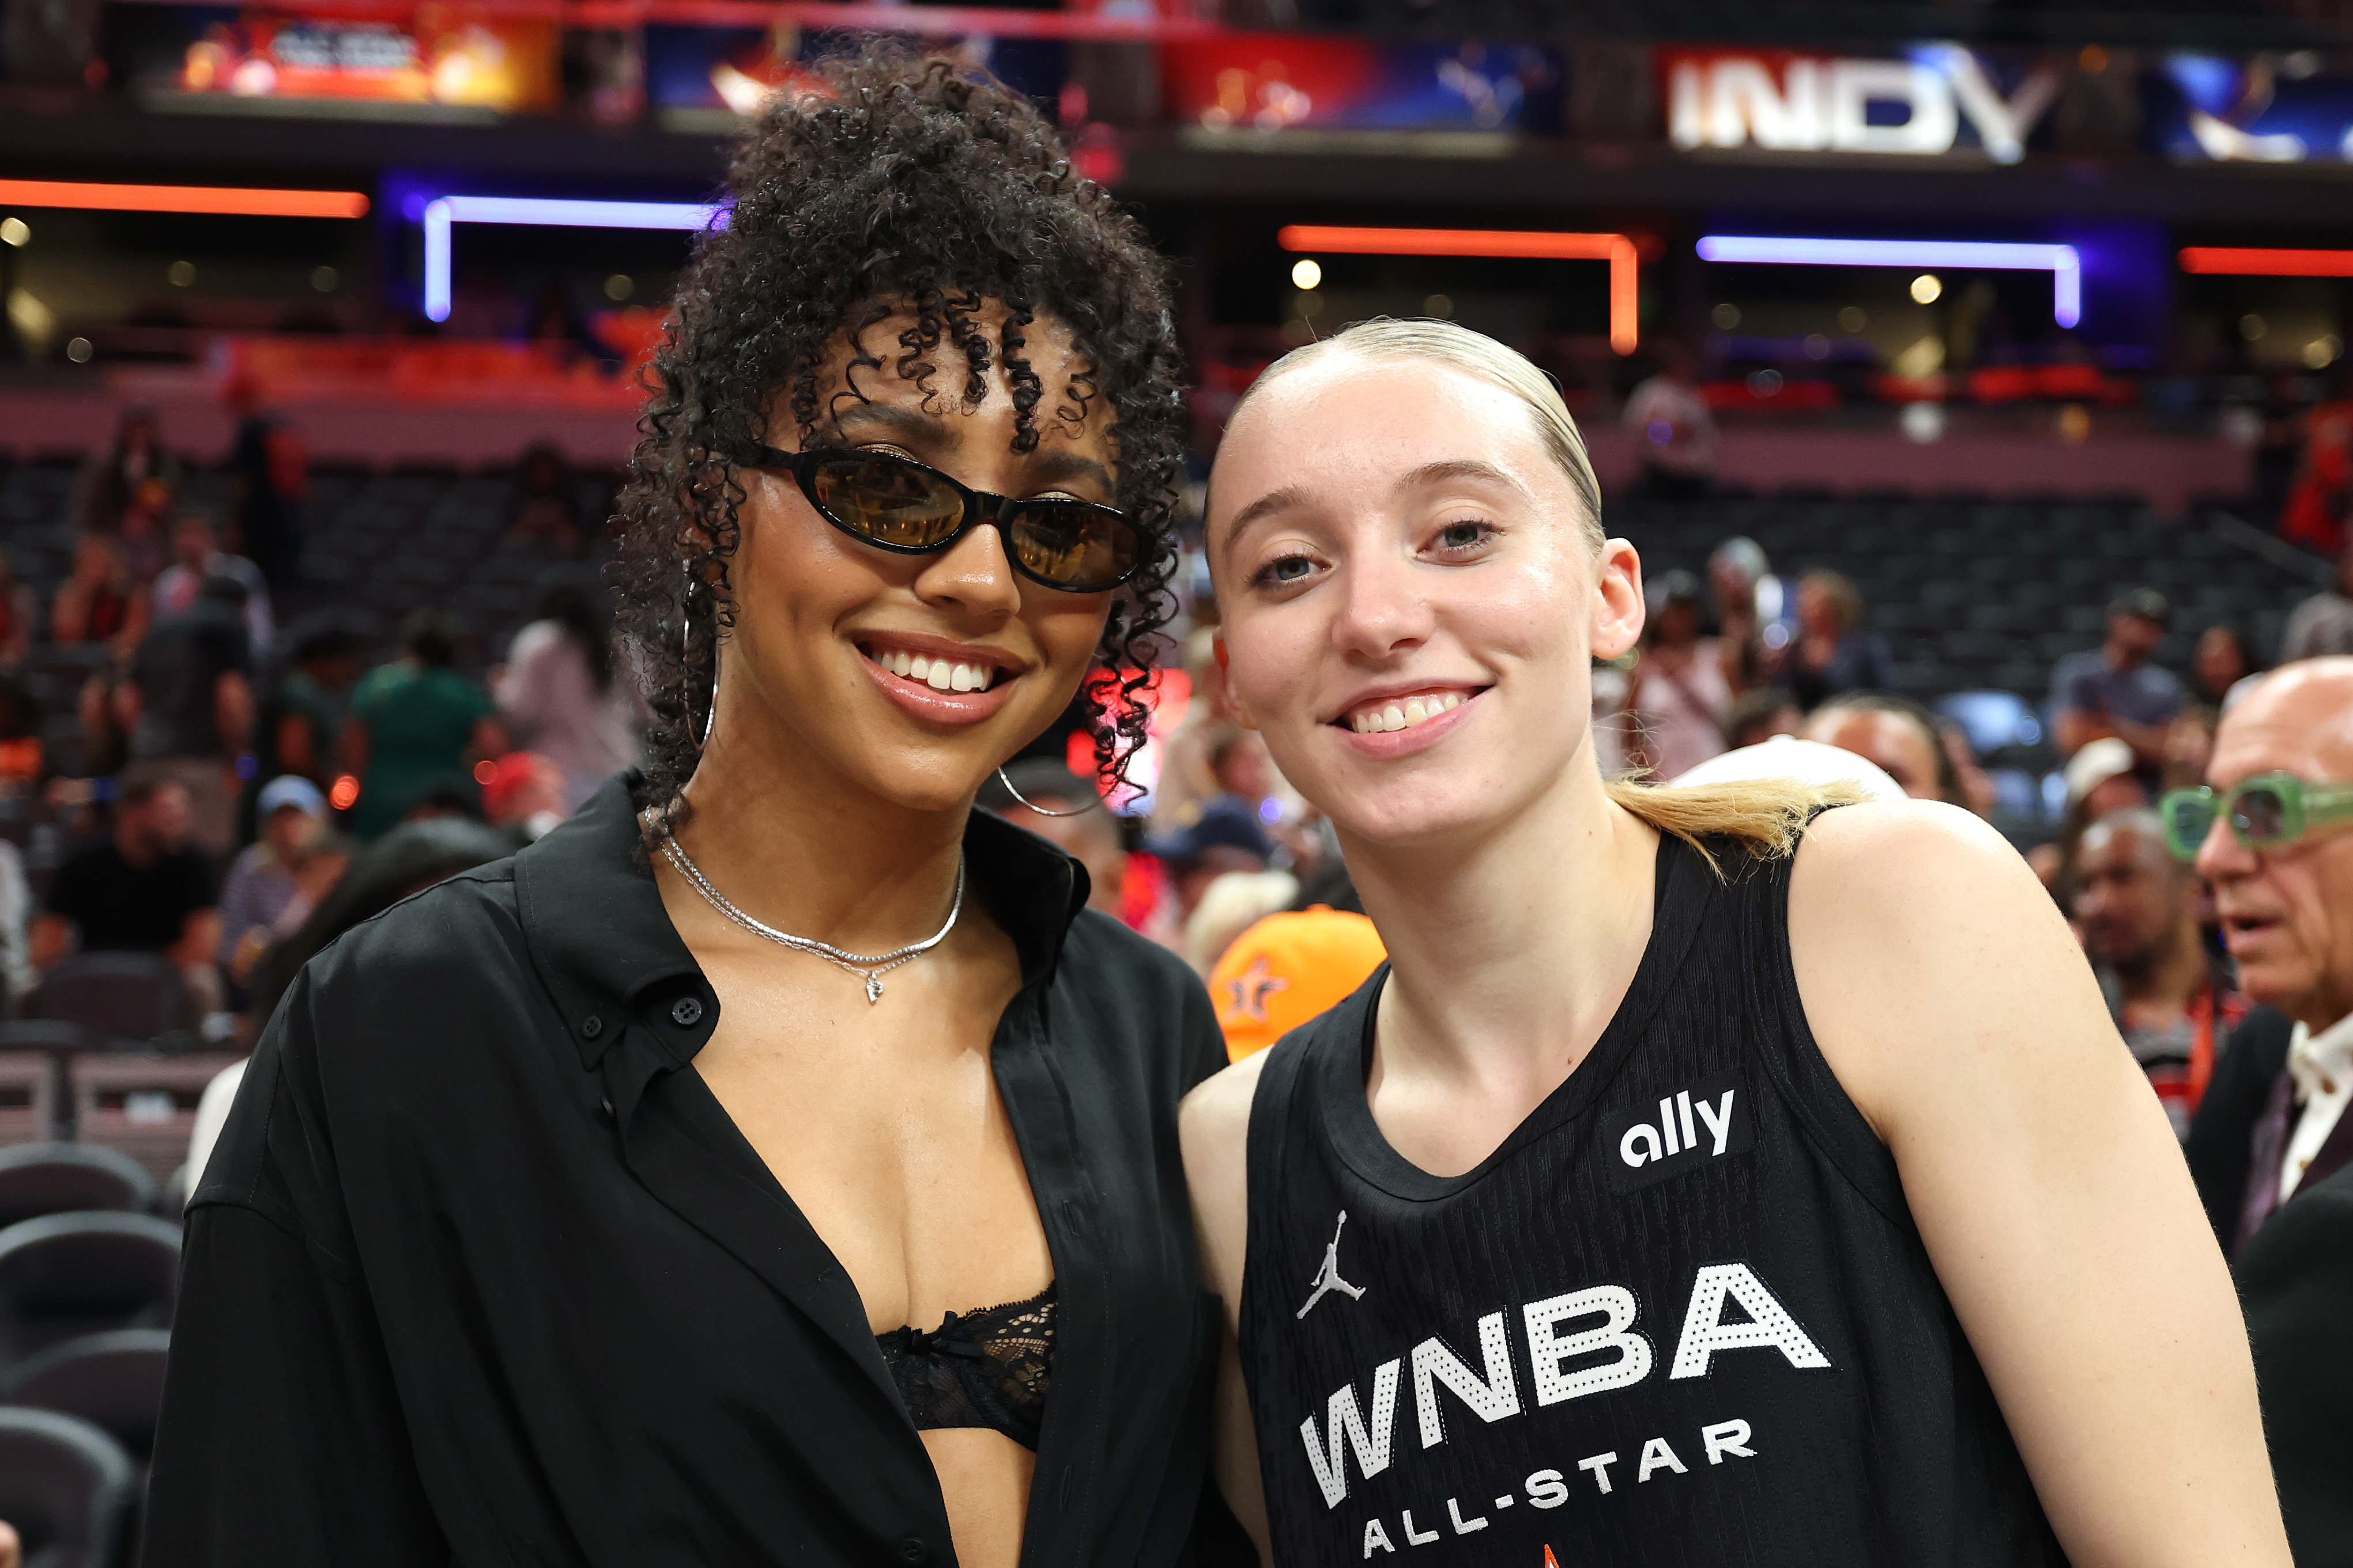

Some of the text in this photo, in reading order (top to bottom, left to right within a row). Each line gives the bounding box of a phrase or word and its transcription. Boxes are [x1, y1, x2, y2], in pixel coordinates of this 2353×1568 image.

[1667, 43, 2059, 165] INDY
[1620, 1089, 1734, 1168] ally
[1299, 1262, 1837, 1509] WNBA
[1363, 1418, 1758, 1559] ALL-STAR
